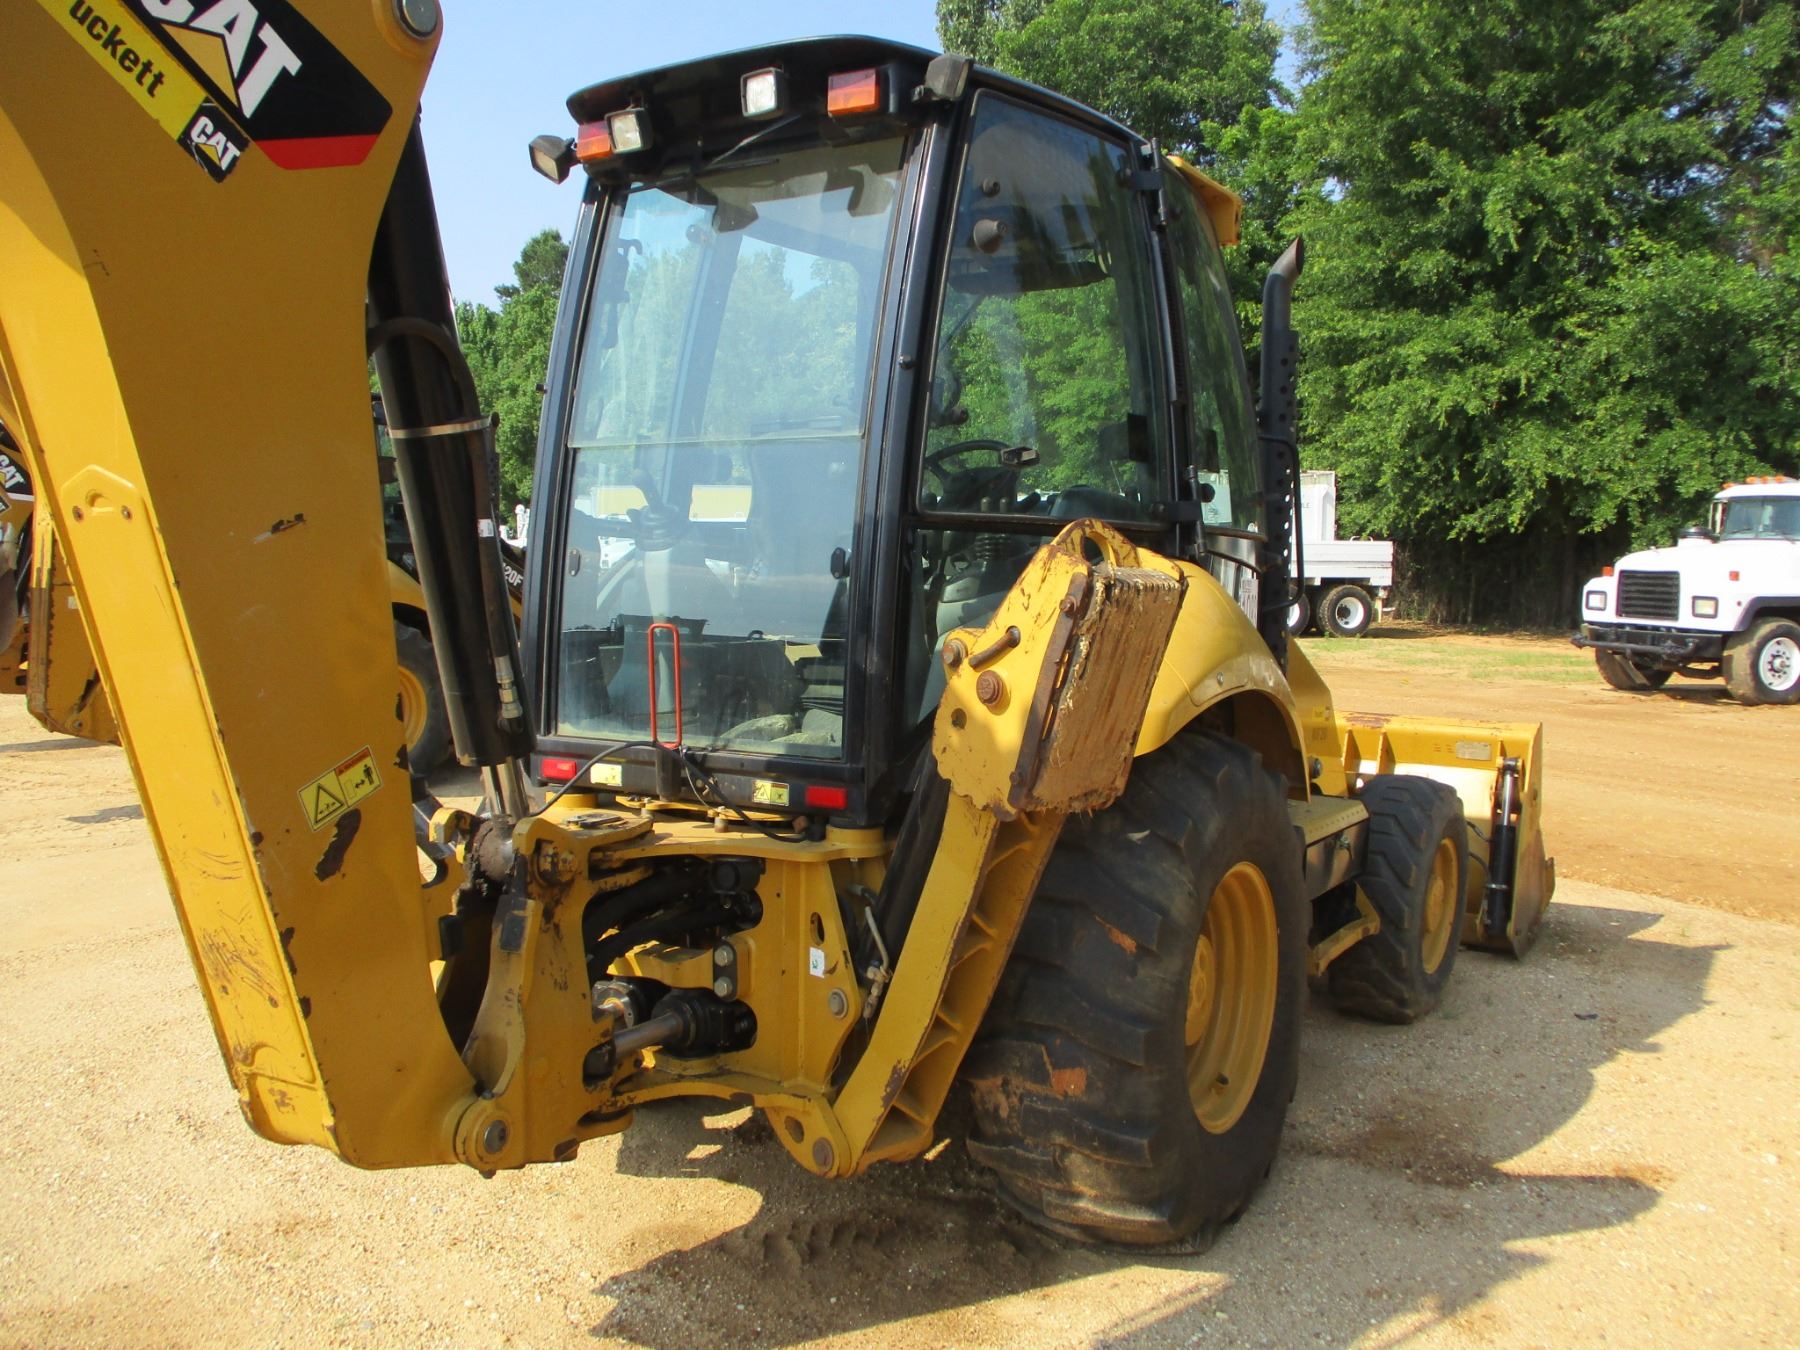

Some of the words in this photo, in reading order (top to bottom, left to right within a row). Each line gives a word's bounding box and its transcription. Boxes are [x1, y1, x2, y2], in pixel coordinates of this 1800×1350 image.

[69, 0, 165, 98] uckett
[141, 0, 302, 119] AT
[190, 116, 241, 171] CAT
[502, 562, 524, 587] 20F
